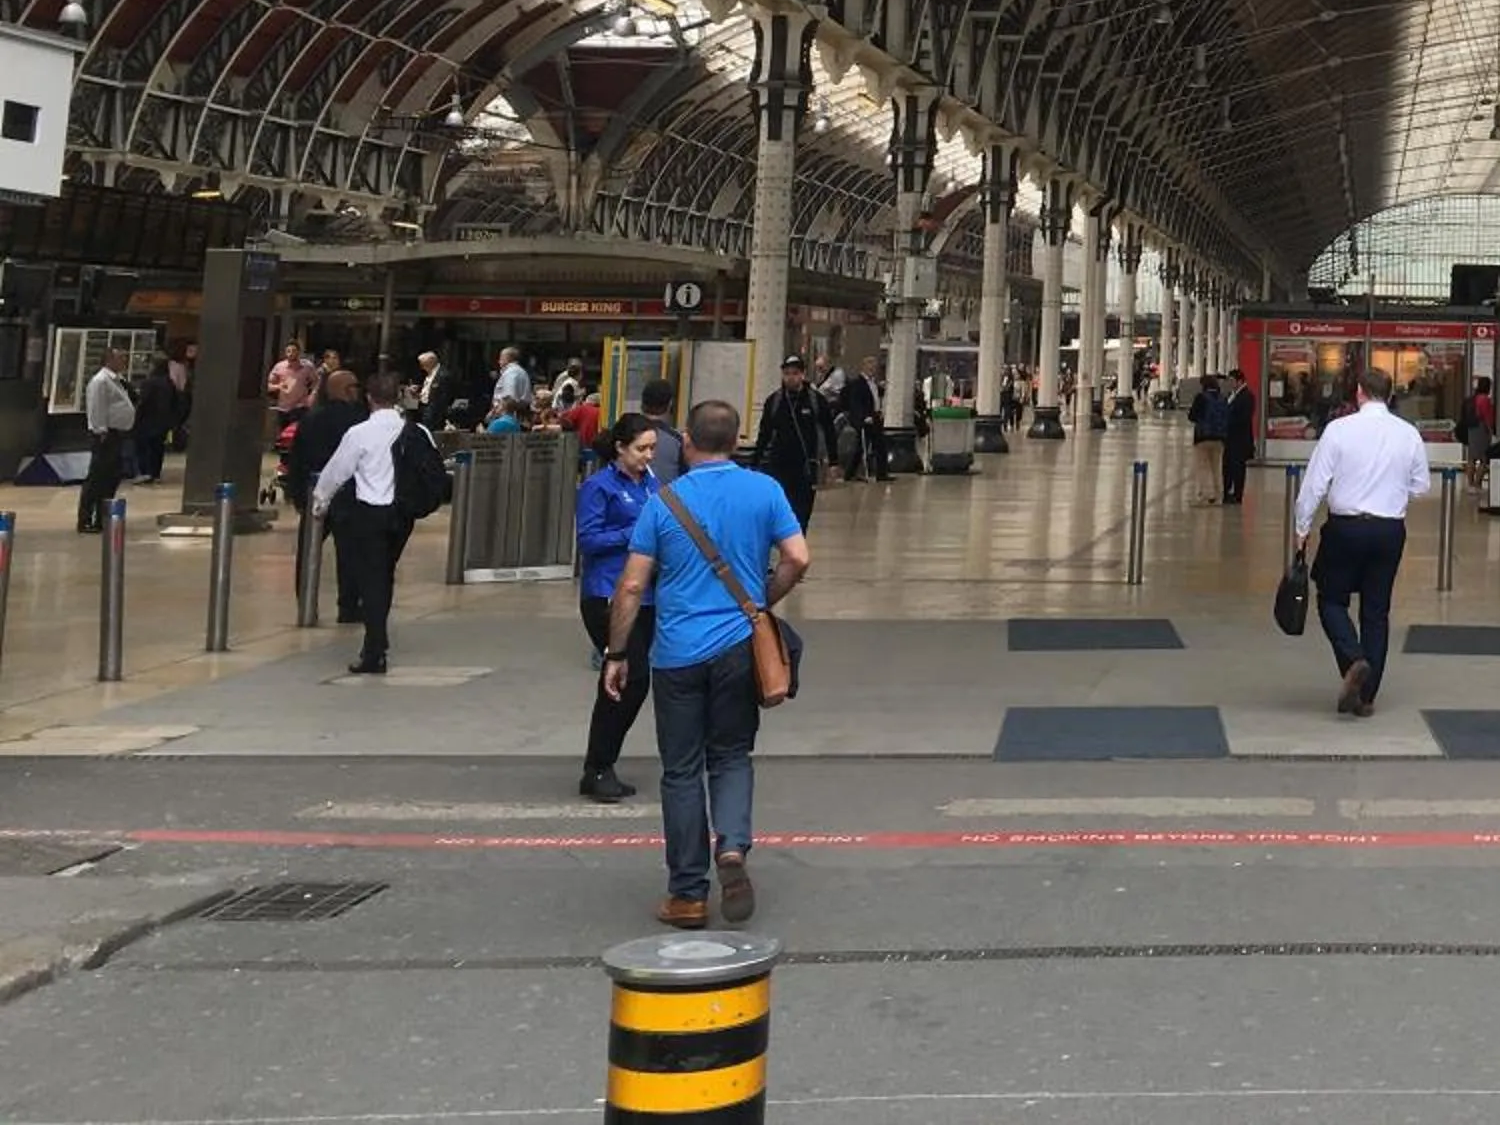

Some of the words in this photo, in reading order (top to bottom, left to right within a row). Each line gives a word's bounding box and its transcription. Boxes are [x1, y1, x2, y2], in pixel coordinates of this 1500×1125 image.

[541, 301, 589, 312] BURGER
[591, 302, 621, 313] KING
[435, 837, 475, 846] NO
[489, 837, 606, 847] SMOKING
[791, 835, 867, 844] POINT
[960, 834, 1000, 843] NO
[1009, 834, 1126, 843] SMOKING
[1134, 833, 1236, 842] BEYOND
[1247, 833, 1299, 842] THIS
[1307, 834, 1381, 844] POINT
